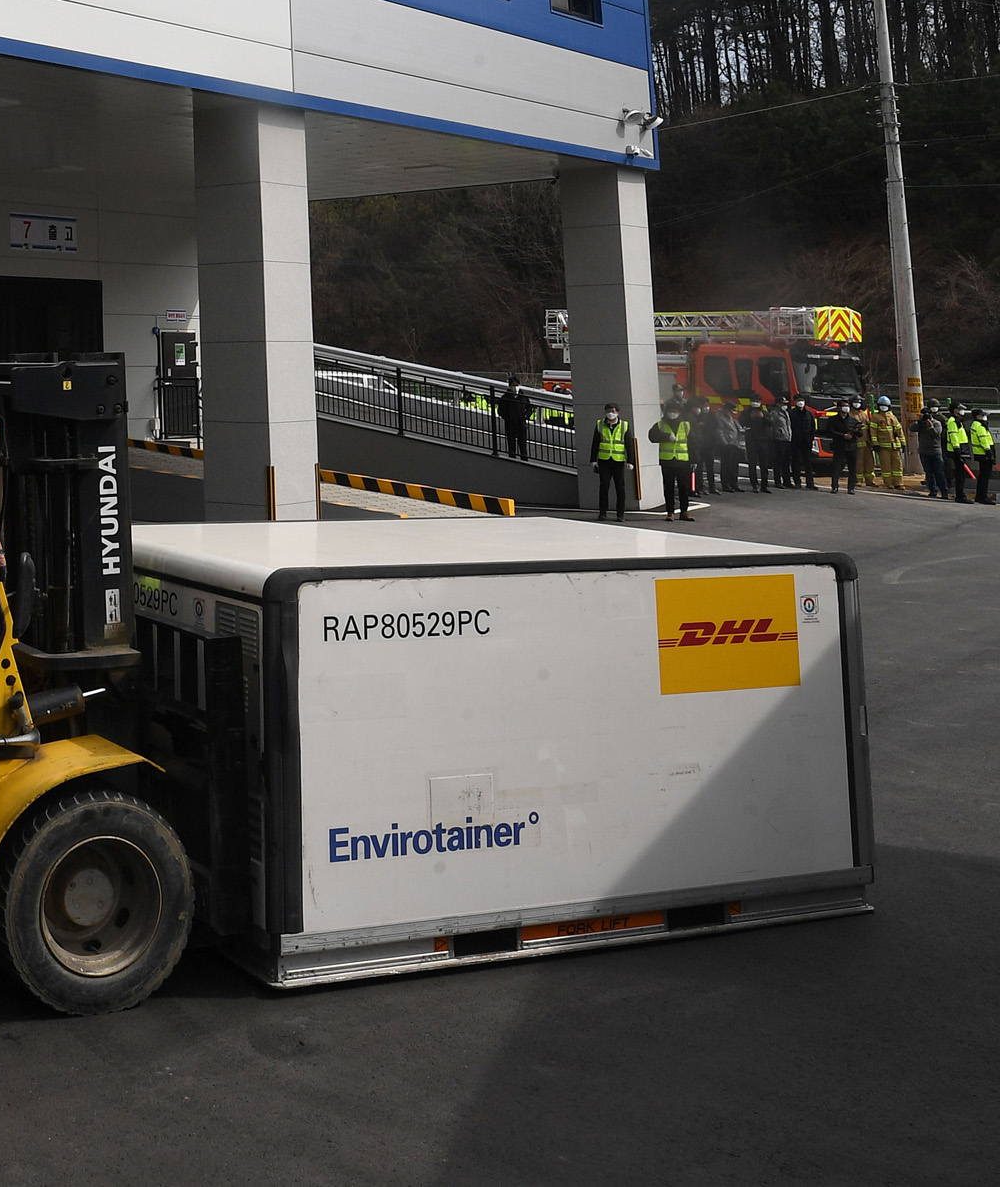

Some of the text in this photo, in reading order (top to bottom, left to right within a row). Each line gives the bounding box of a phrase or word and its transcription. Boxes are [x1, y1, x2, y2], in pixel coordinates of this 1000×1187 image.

[23, 221, 32, 239] 7
[98, 445, 121, 575] HYUNDAI
[323, 610, 491, 642] RAP80529PC
[678, 618, 780, 647] DHL
[557, 917, 630, 937] FORK LIFT
